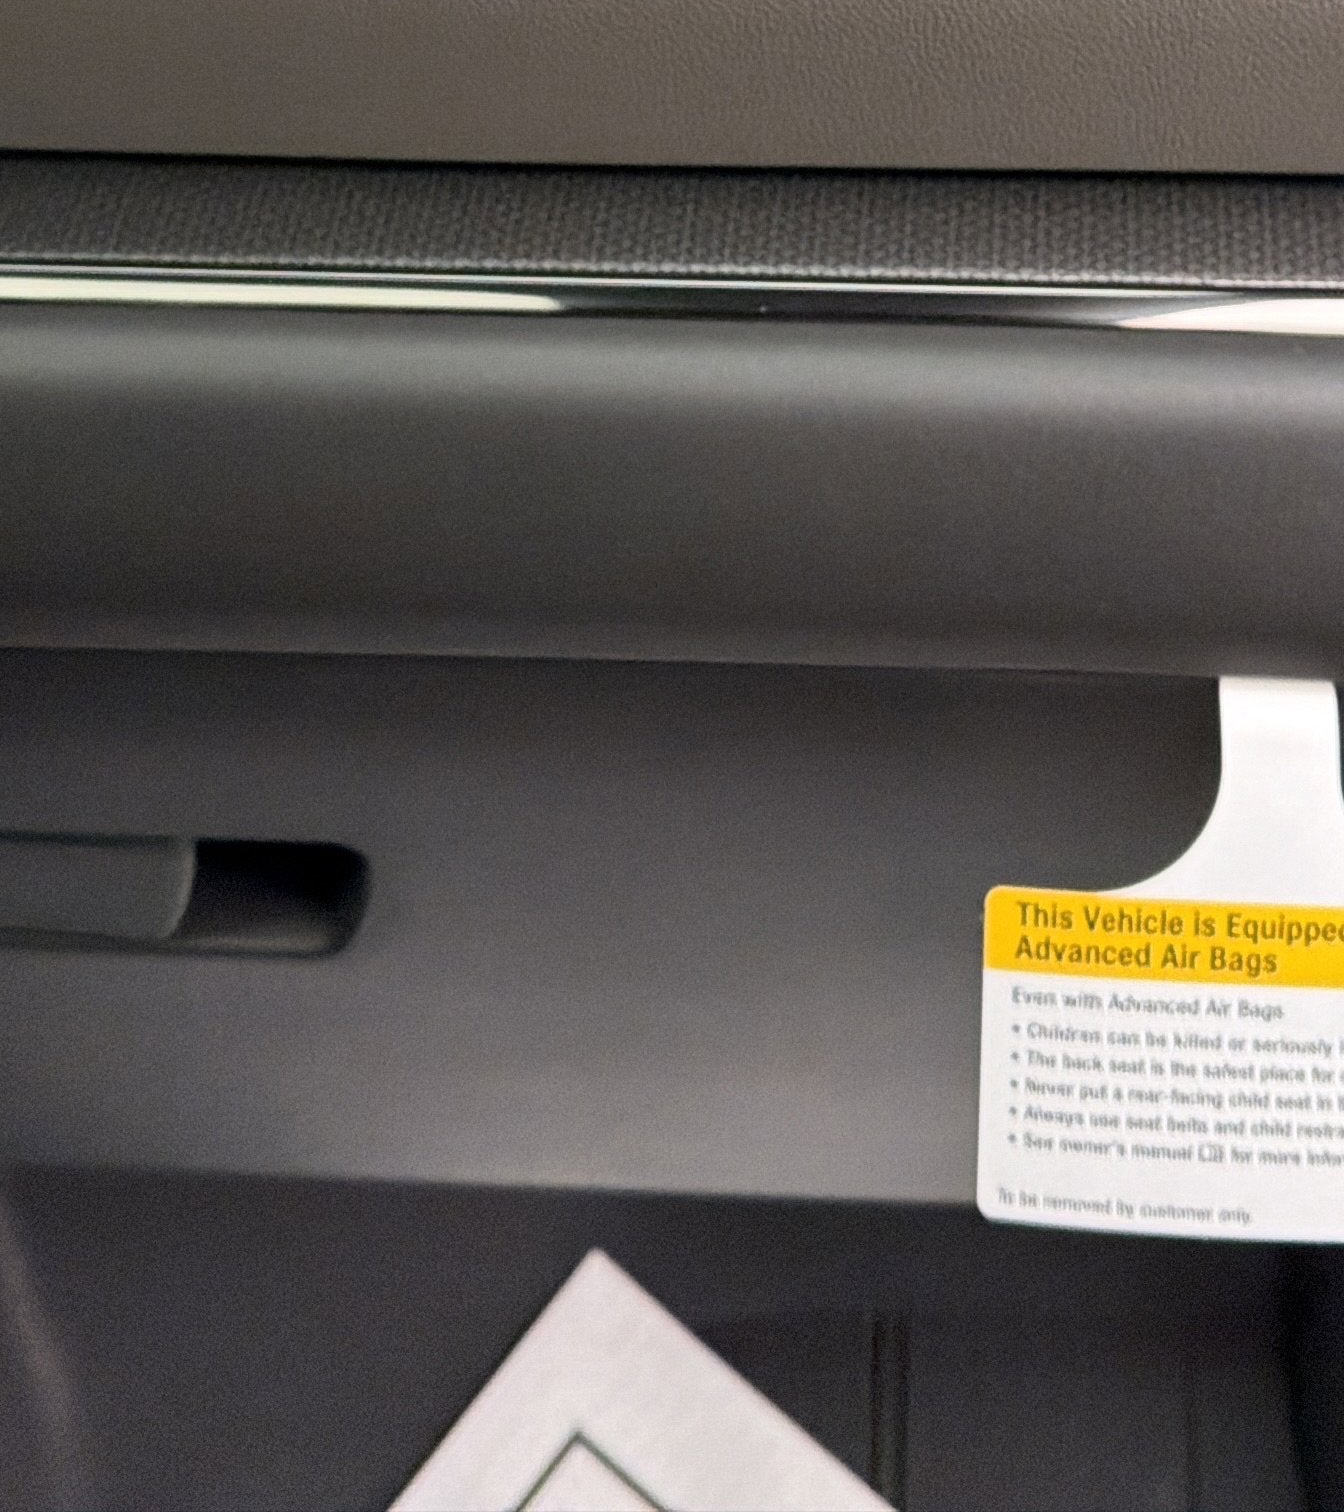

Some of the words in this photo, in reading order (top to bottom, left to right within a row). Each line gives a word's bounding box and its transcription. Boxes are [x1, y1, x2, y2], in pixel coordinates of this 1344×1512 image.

[1016, 901, 1072, 930] This
[1083, 906, 1183, 937] Vehicle
[1194, 911, 1215, 938] is
[1015, 935, 1150, 969] Advanced
[1161, 944, 1200, 971] Air
[1210, 947, 1276, 979] Bags
[1012, 985, 1057, 1008] Even
[1062, 993, 1103, 1011] with
[1108, 994, 1200, 1017] Advanced
[1206, 999, 1231, 1019] Air
[1238, 1001, 1284, 1023] Bags
